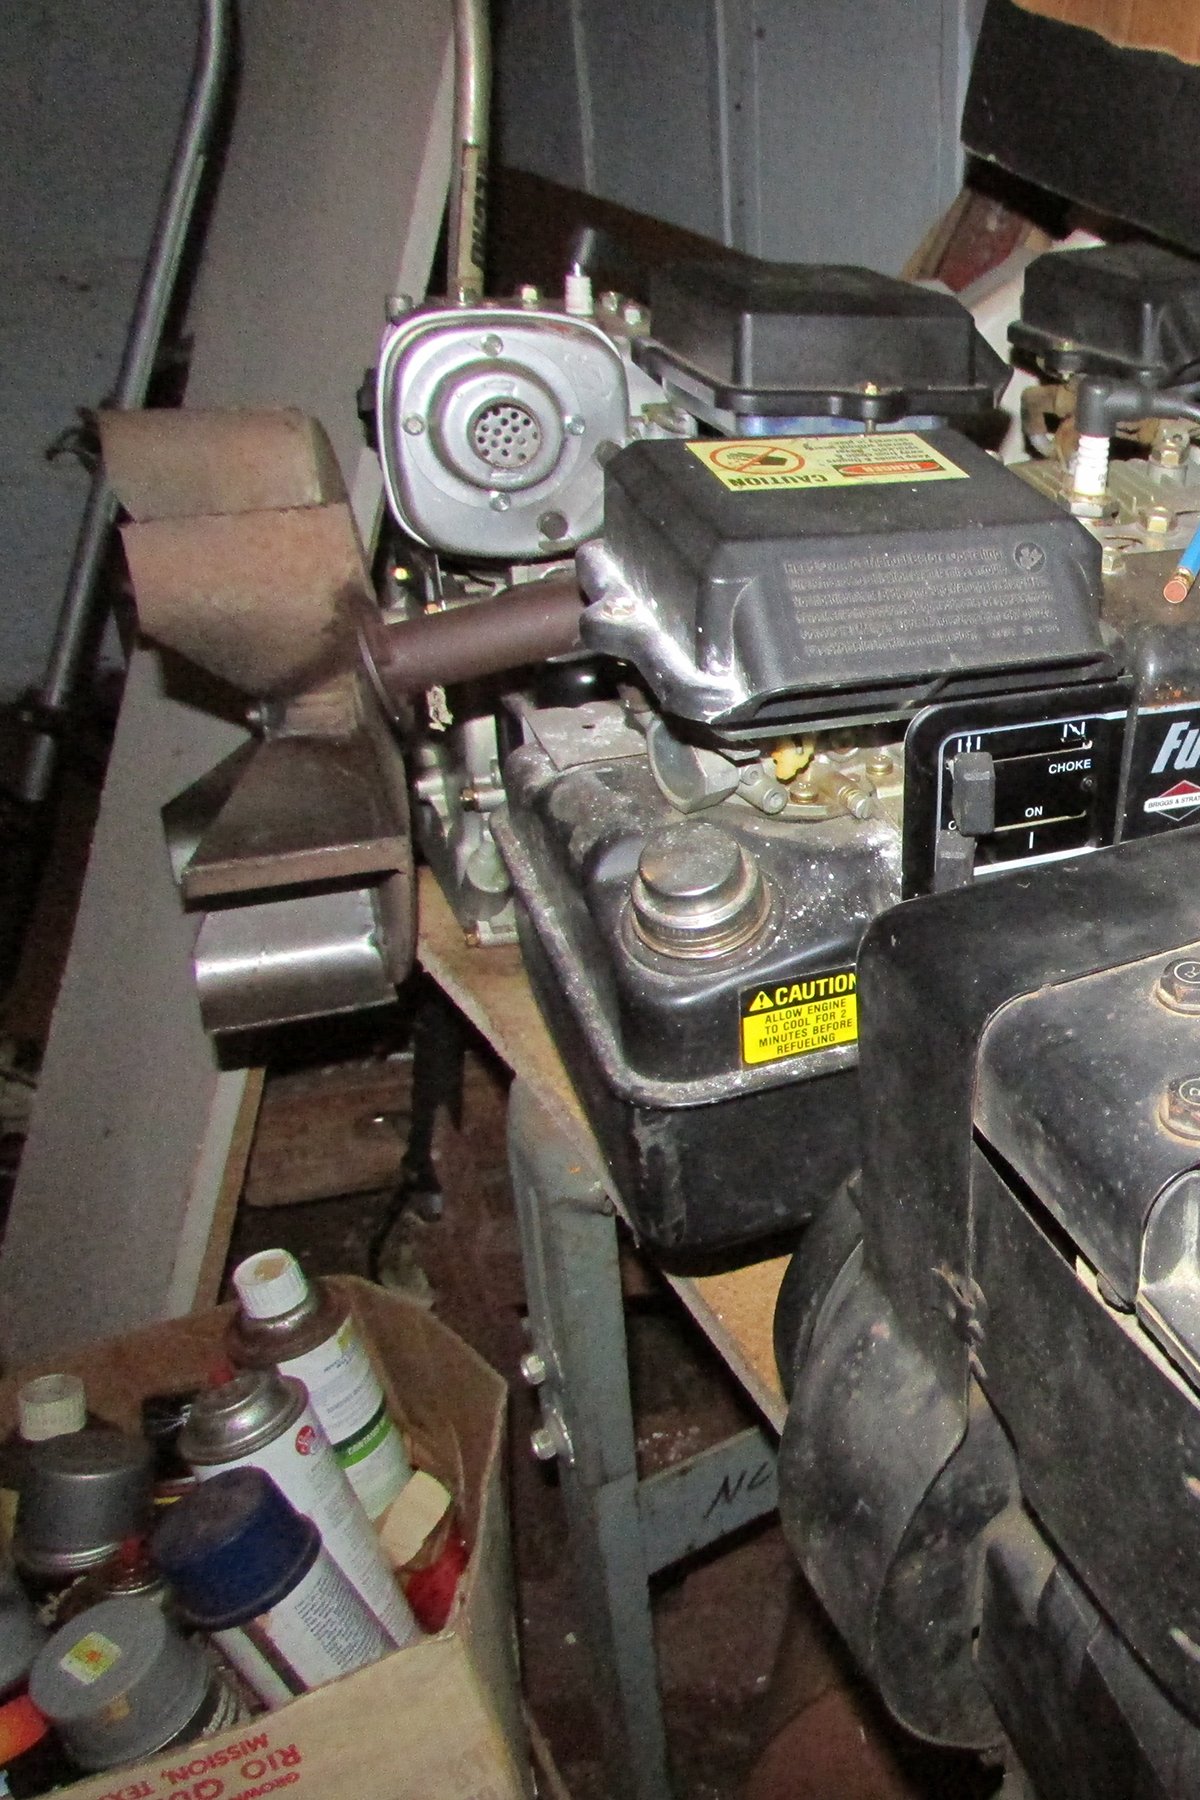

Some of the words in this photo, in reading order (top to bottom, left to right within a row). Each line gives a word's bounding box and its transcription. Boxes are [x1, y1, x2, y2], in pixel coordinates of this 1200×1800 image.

[862, 463, 921, 473] DANGER
[727, 474, 829, 487] CAUTION
[1048, 758, 1092, 775] CHOKE
[1025, 805, 1043, 818] ON
[1148, 799, 1174, 809] BRIGGS
[775, 973, 856, 1006] CAUTION
[765, 1008, 803, 1025] ALLOW
[807, 998, 847, 1015] ENGINE
[765, 1024, 778, 1035] TO
[783, 1017, 811, 1031] COOL
[815, 1011, 836, 1024] FOR
[841, 1009, 847, 1019] 2
[759, 1028, 808, 1048] MINUTES
[812, 1018, 853, 1035] BEFORE
[777, 1033, 835, 1055] REFUELING
[160, 1732, 269, 1785] MISSION,
[240, 1743, 302, 1780] RIO
